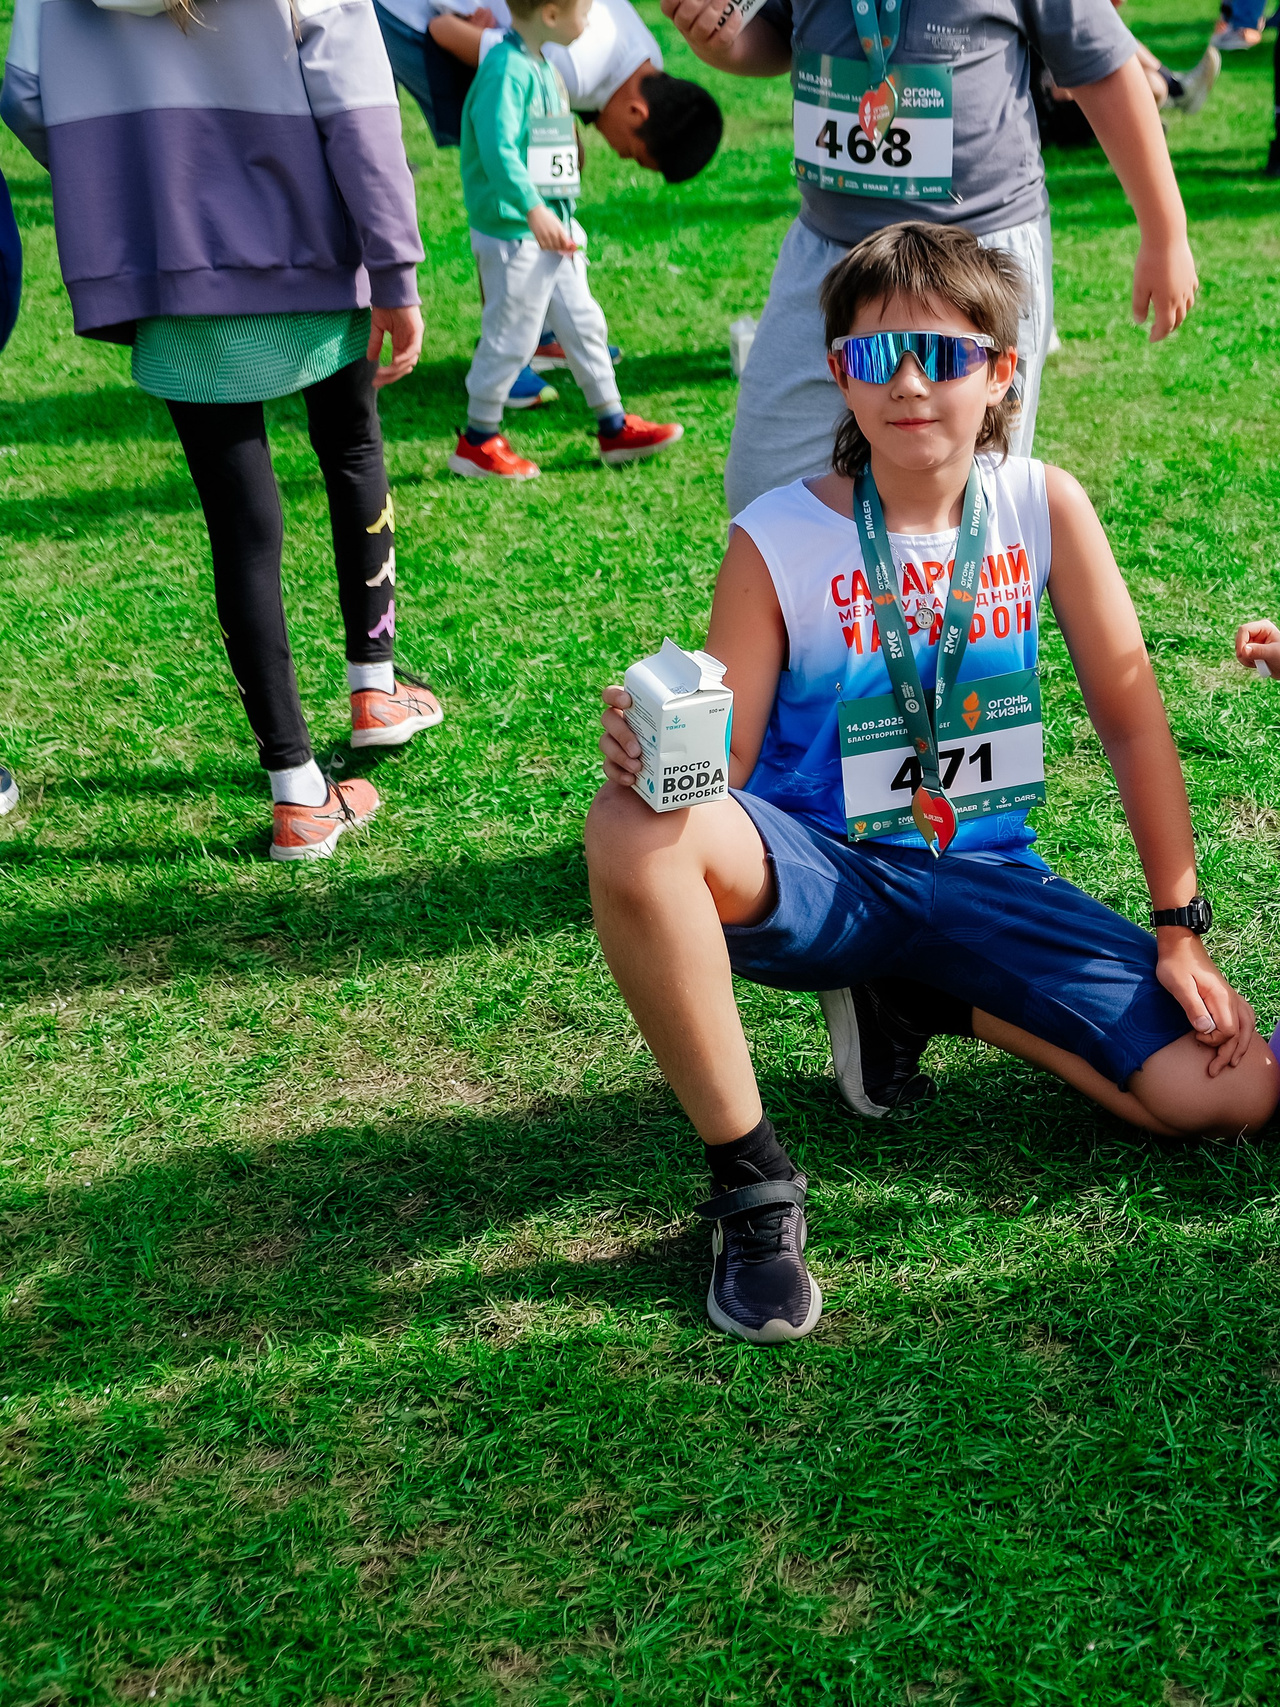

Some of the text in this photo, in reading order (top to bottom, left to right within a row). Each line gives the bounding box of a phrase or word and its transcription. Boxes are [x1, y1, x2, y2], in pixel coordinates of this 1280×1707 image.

[900, 96, 944, 108] ЖИЗНИ
[903, 87, 941, 98] ОГОНЬ
[816, 119, 912, 167] 468
[862, 499, 874, 531] MAER
[973, 493, 982, 528] MAER
[960, 561, 970, 587] ОГОНЬ
[966, 560, 976, 590] ЖИЗНИ
[987, 694, 1029, 710] ОГОНЬ
[985, 704, 1032, 721] ЖИЗНИ
[846, 716, 904, 733] 14.09.2025
[663, 760, 711, 776] ПРОСТО
[890, 742, 993, 796] 471
[662, 796, 669, 805] В
[671, 784, 725, 803] КОРОБКЕ
[1014, 793, 1036, 803] DARS
